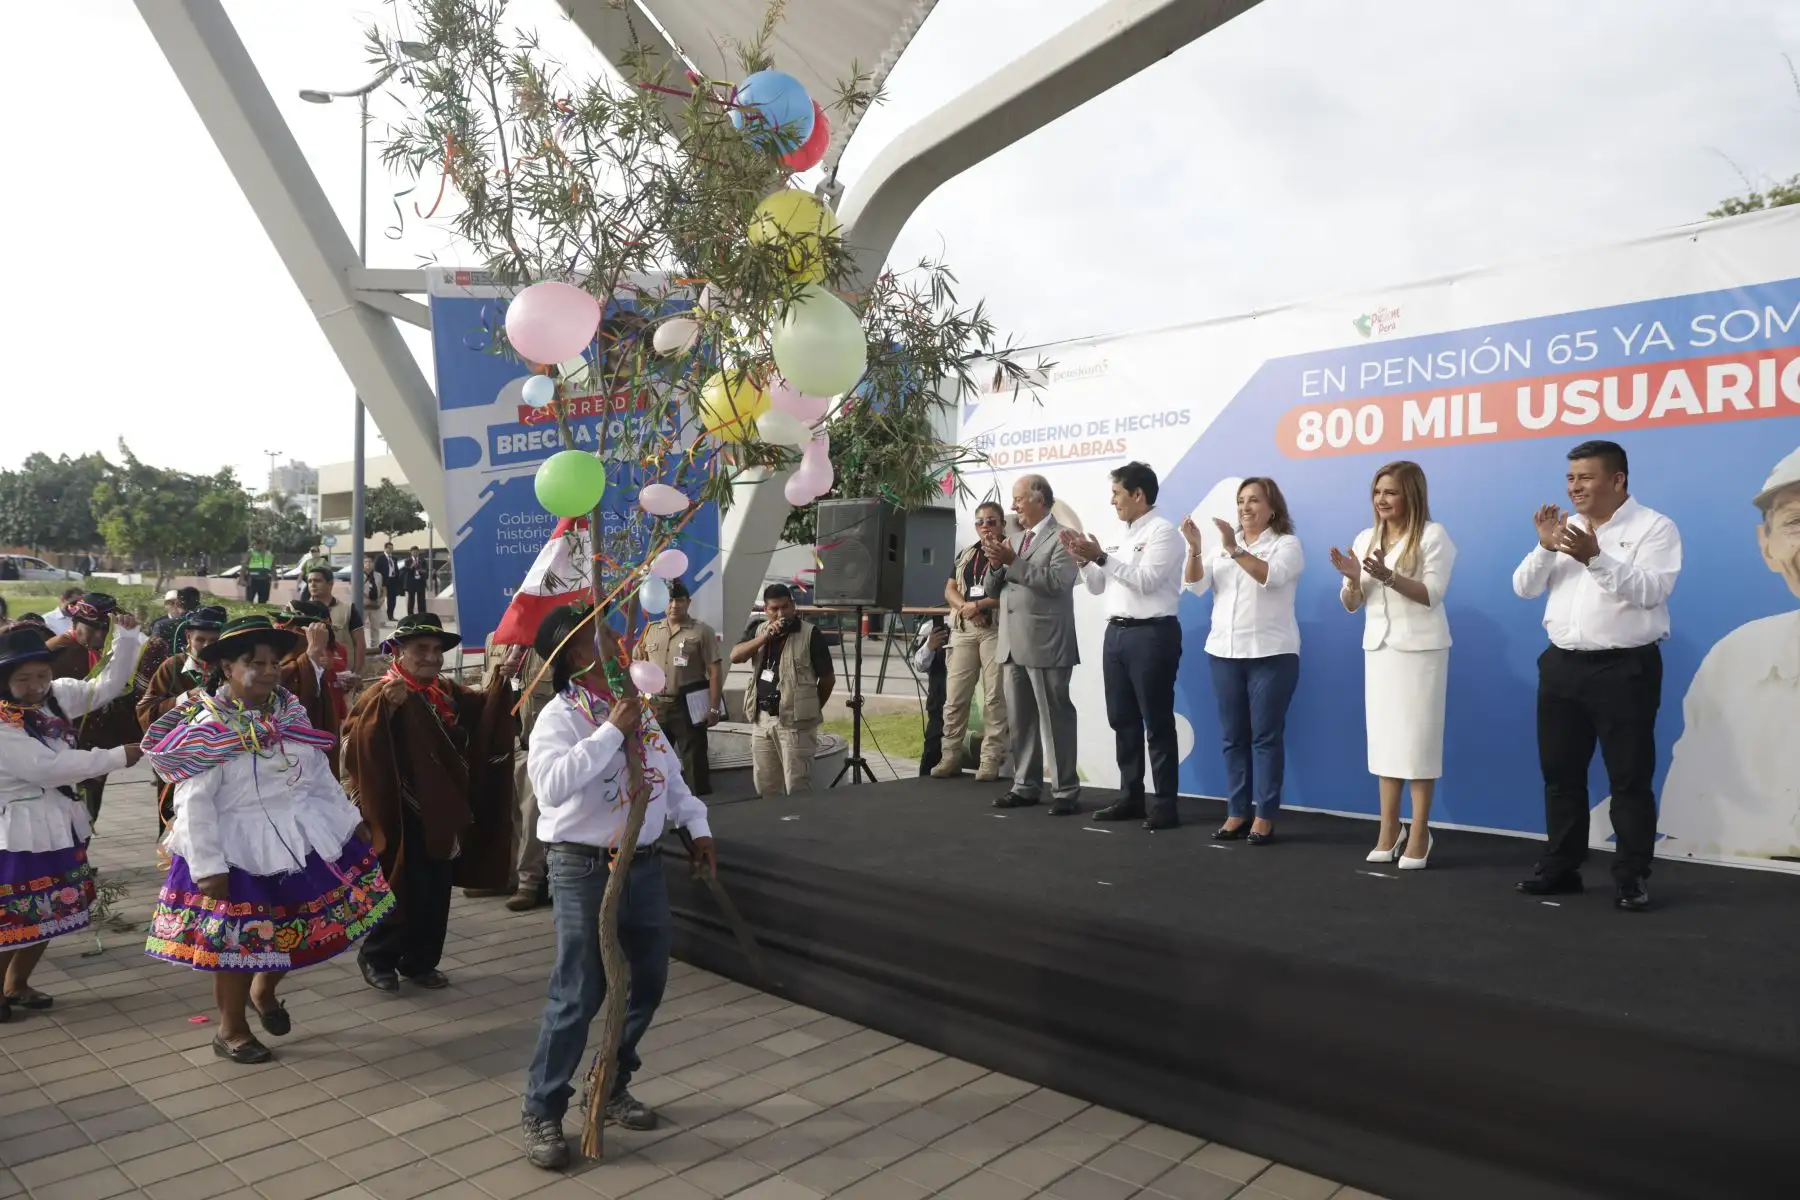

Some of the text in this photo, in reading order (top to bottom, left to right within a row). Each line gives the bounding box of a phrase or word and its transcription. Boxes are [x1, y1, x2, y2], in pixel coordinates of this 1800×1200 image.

[1302, 365, 1346, 397] EN
[1360, 337, 1531, 389] PENSIÓN
[1547, 329, 1598, 365] 65
[1613, 321, 1675, 356] YA
[975, 409, 1191, 449] UN GOBIERNO DE HECHOS
[1296, 404, 1384, 451] 800
[1402, 392, 1498, 441] MIL
[1013, 449, 1034, 464] DE
[1038, 437, 1128, 461] PALABRAS
